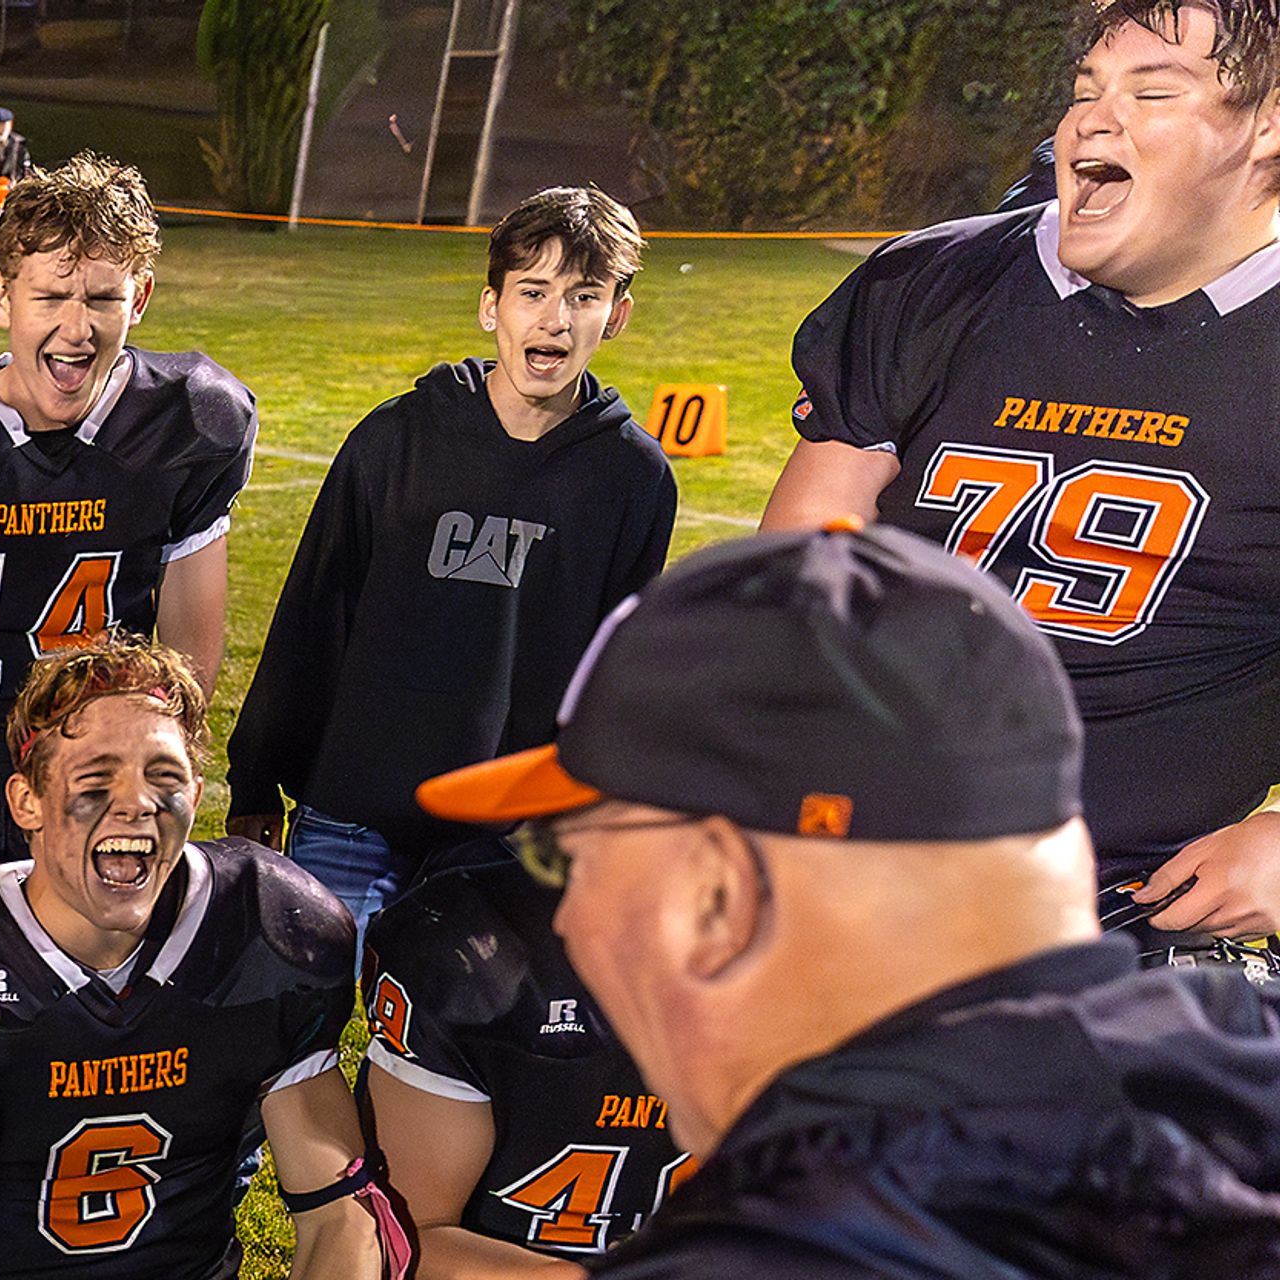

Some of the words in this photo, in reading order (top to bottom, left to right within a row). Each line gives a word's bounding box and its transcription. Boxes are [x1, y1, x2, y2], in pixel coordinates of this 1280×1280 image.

[657, 393, 705, 446] 10
[993, 396, 1190, 448] PANTHERS
[427, 511, 548, 588] CAT
[915, 442, 1212, 647] 79
[539, 1022, 586, 1034] RUSSELL
[548, 999, 578, 1024] R
[48, 1047, 190, 1098] PANTHERS
[595, 1095, 669, 1129] PANT
[38, 1112, 174, 1255] 6
